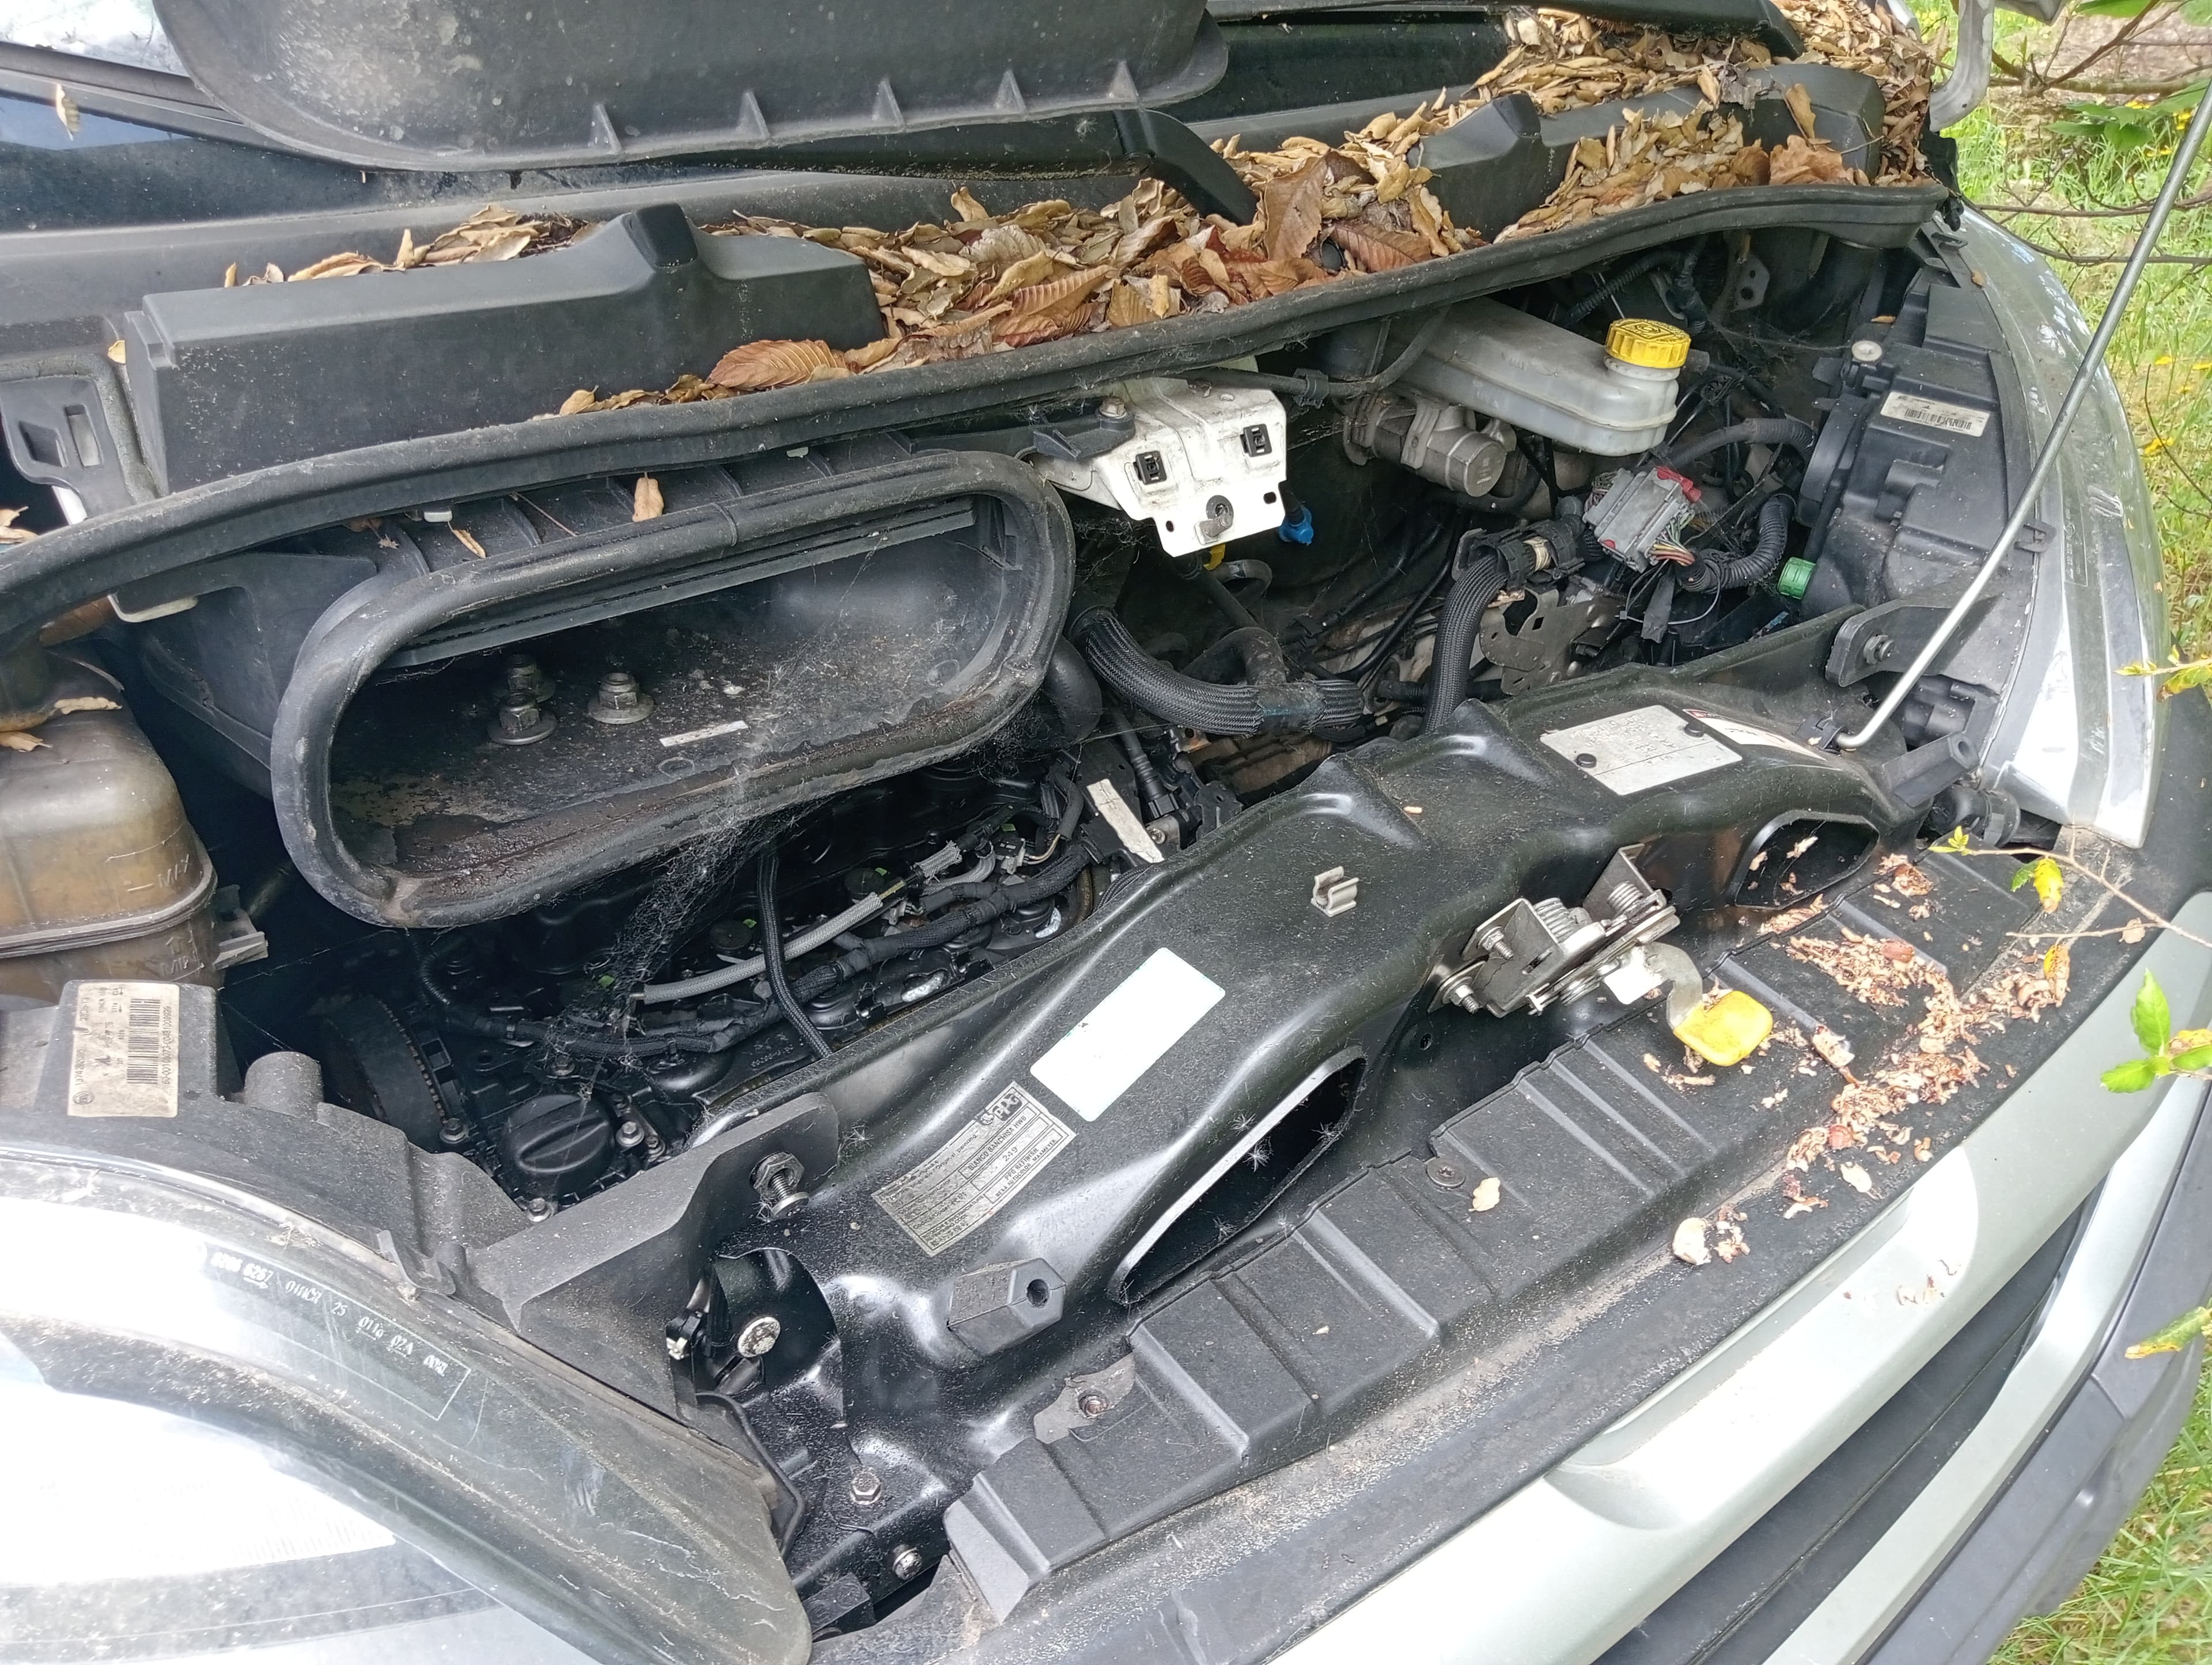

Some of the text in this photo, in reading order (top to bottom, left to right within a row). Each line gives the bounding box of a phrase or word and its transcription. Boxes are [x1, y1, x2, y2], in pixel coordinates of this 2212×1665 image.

[967, 1150, 990, 1171] BIANCO
[987, 1127, 1014, 1152] BANCHISA
[1002, 1146, 1018, 1162] 249
[331, 1302, 349, 1317] 25
